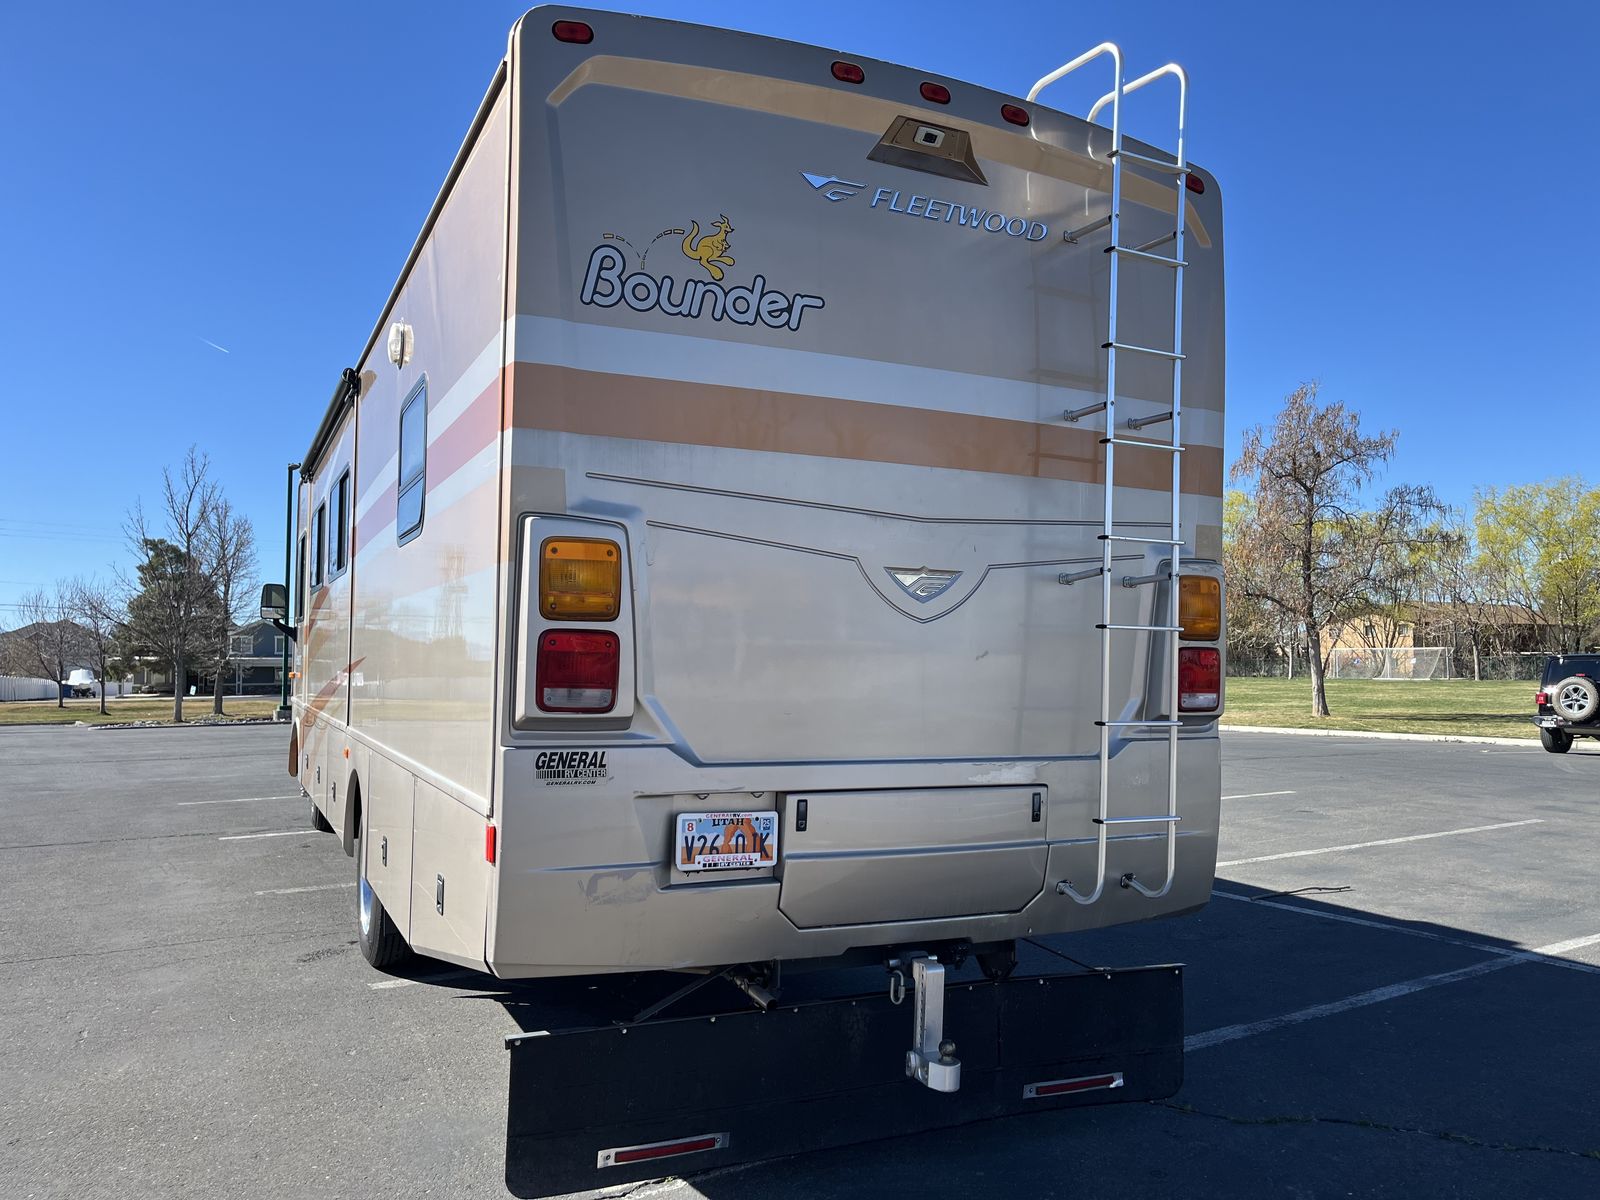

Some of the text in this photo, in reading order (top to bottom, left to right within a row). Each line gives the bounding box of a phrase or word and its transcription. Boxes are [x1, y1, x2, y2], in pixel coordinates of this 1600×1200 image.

[870, 186, 1048, 242] FLEETWOOD
[580, 244, 826, 331] Bounder
[535, 751, 607, 770] GENERAL
[564, 769, 606, 778] RV CENTER
[687, 822, 694, 831] 8
[712, 818, 744, 827] UTAH
[703, 855, 753, 863] GENERAL
